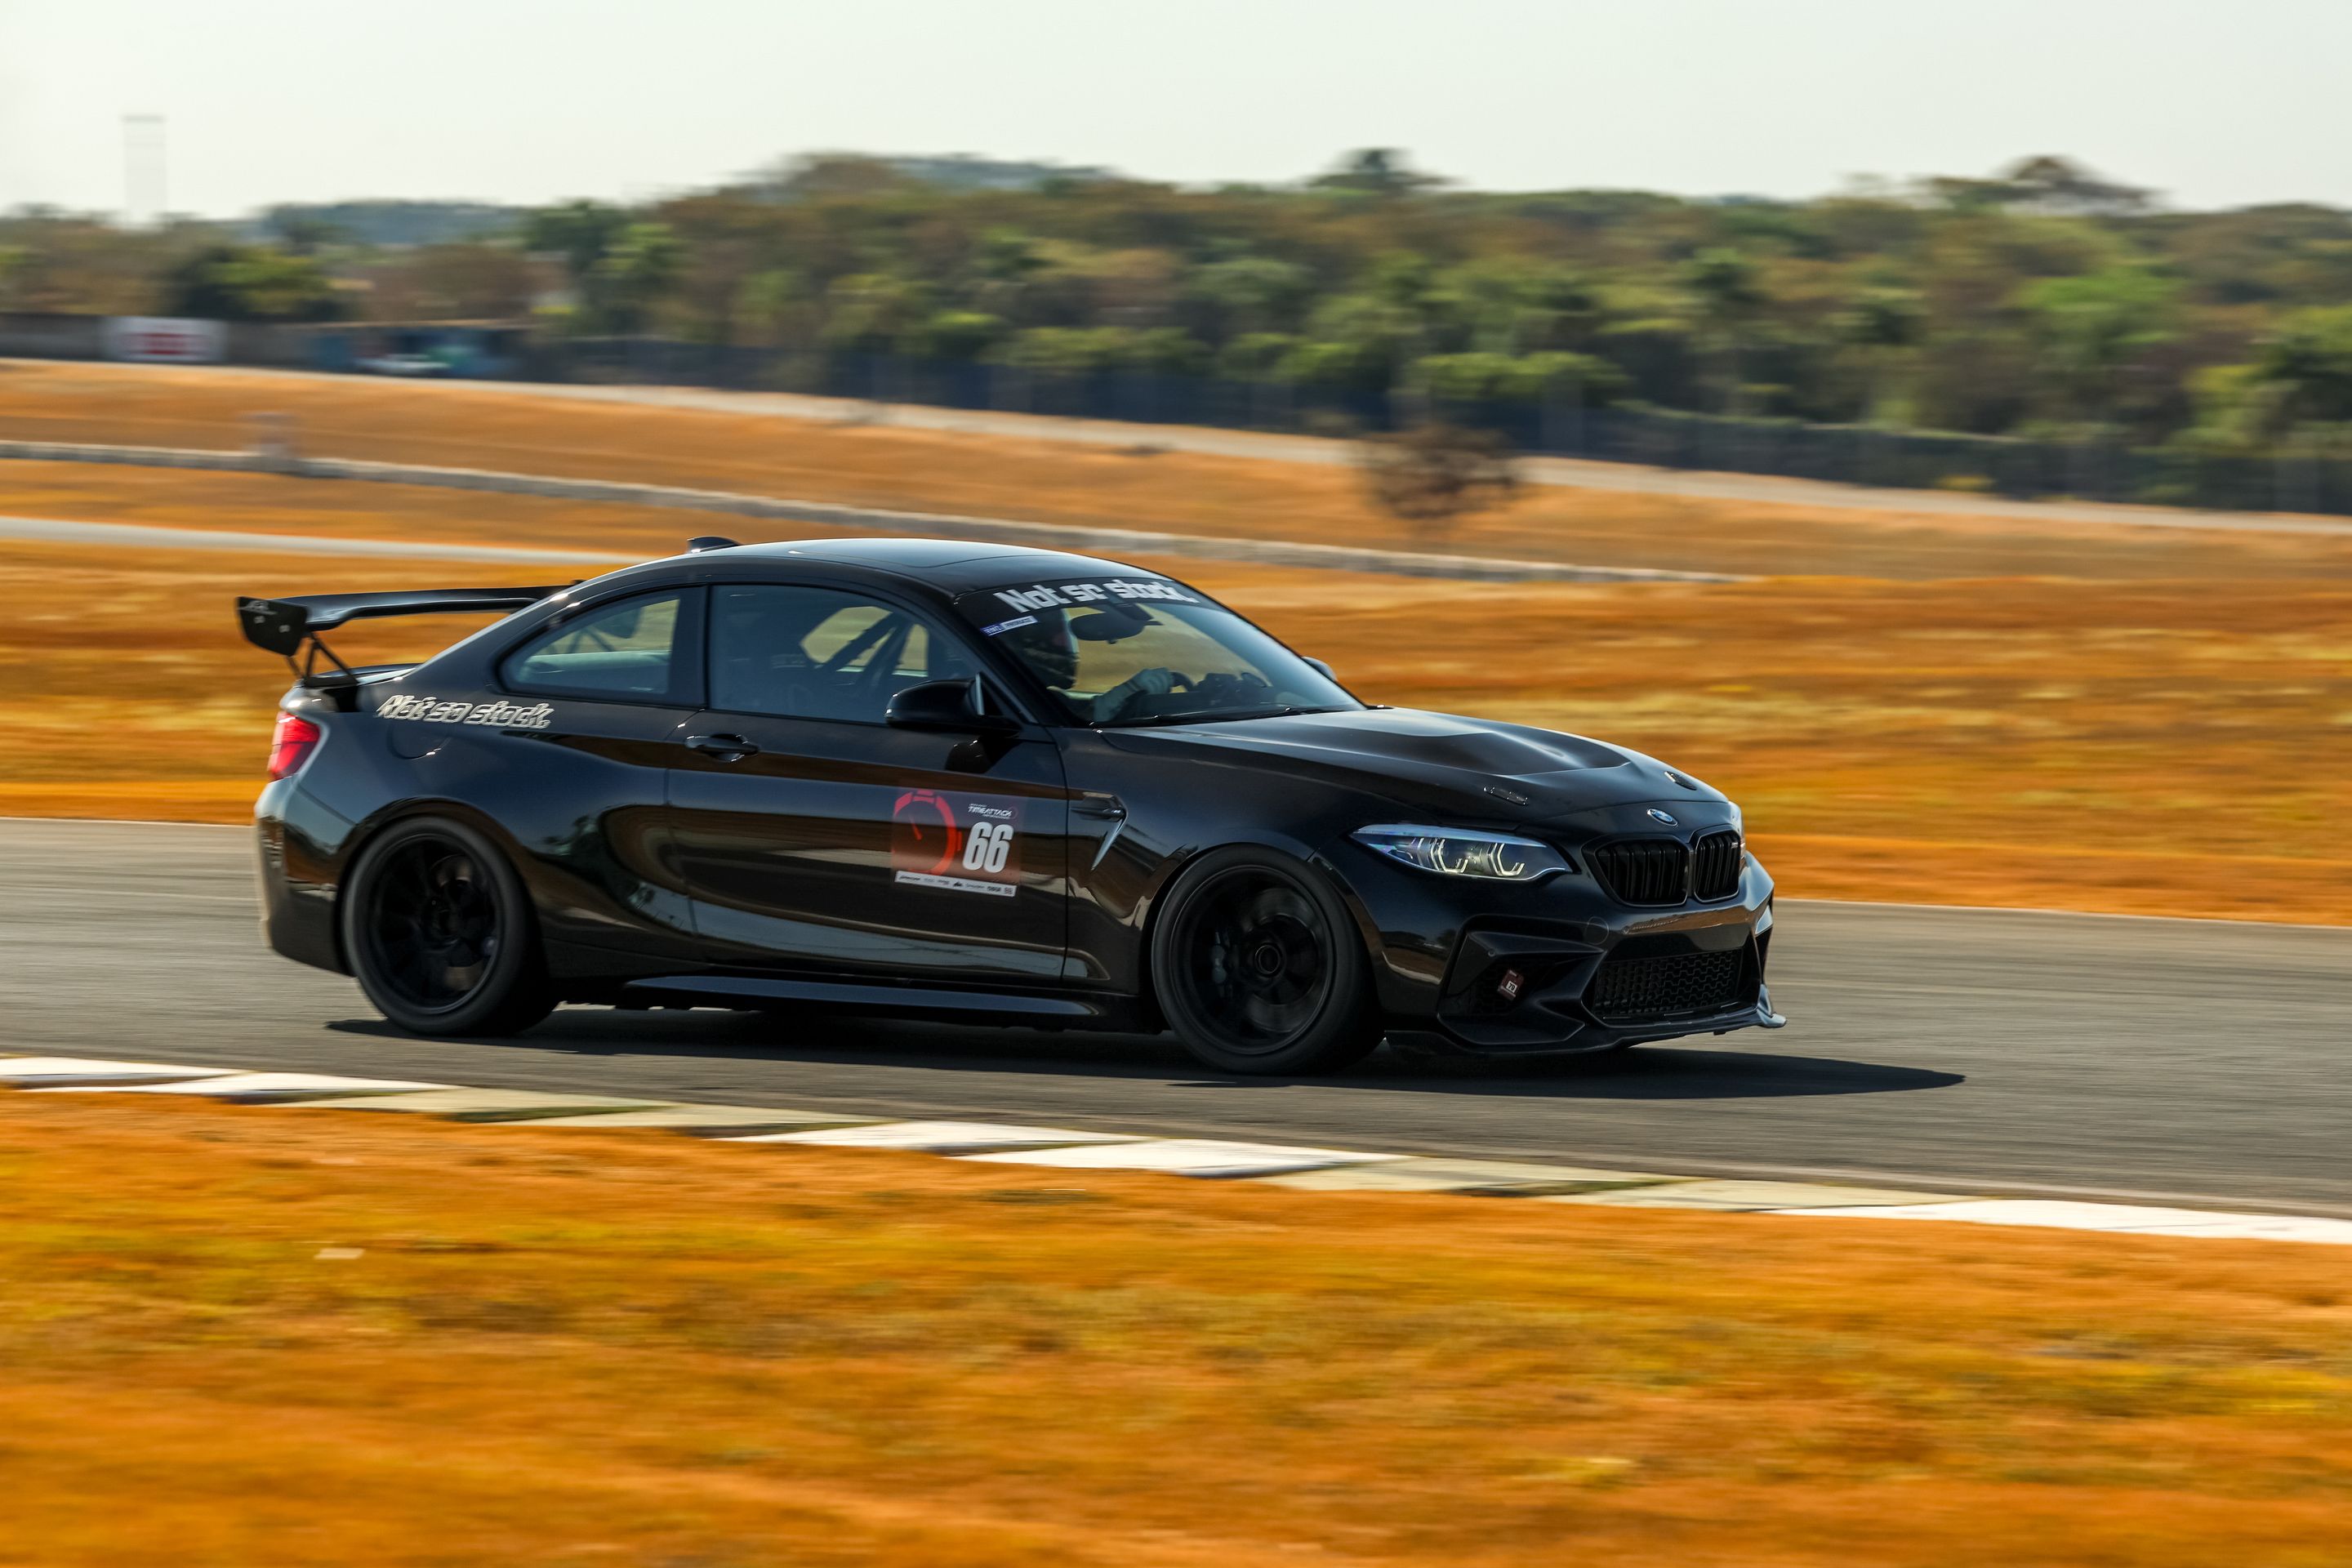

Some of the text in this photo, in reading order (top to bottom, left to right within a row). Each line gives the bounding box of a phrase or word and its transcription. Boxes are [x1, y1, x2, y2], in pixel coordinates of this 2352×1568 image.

[993, 584, 1071, 612] Not
[376, 694, 555, 729] Not so stock
[962, 822, 1014, 873] 66
